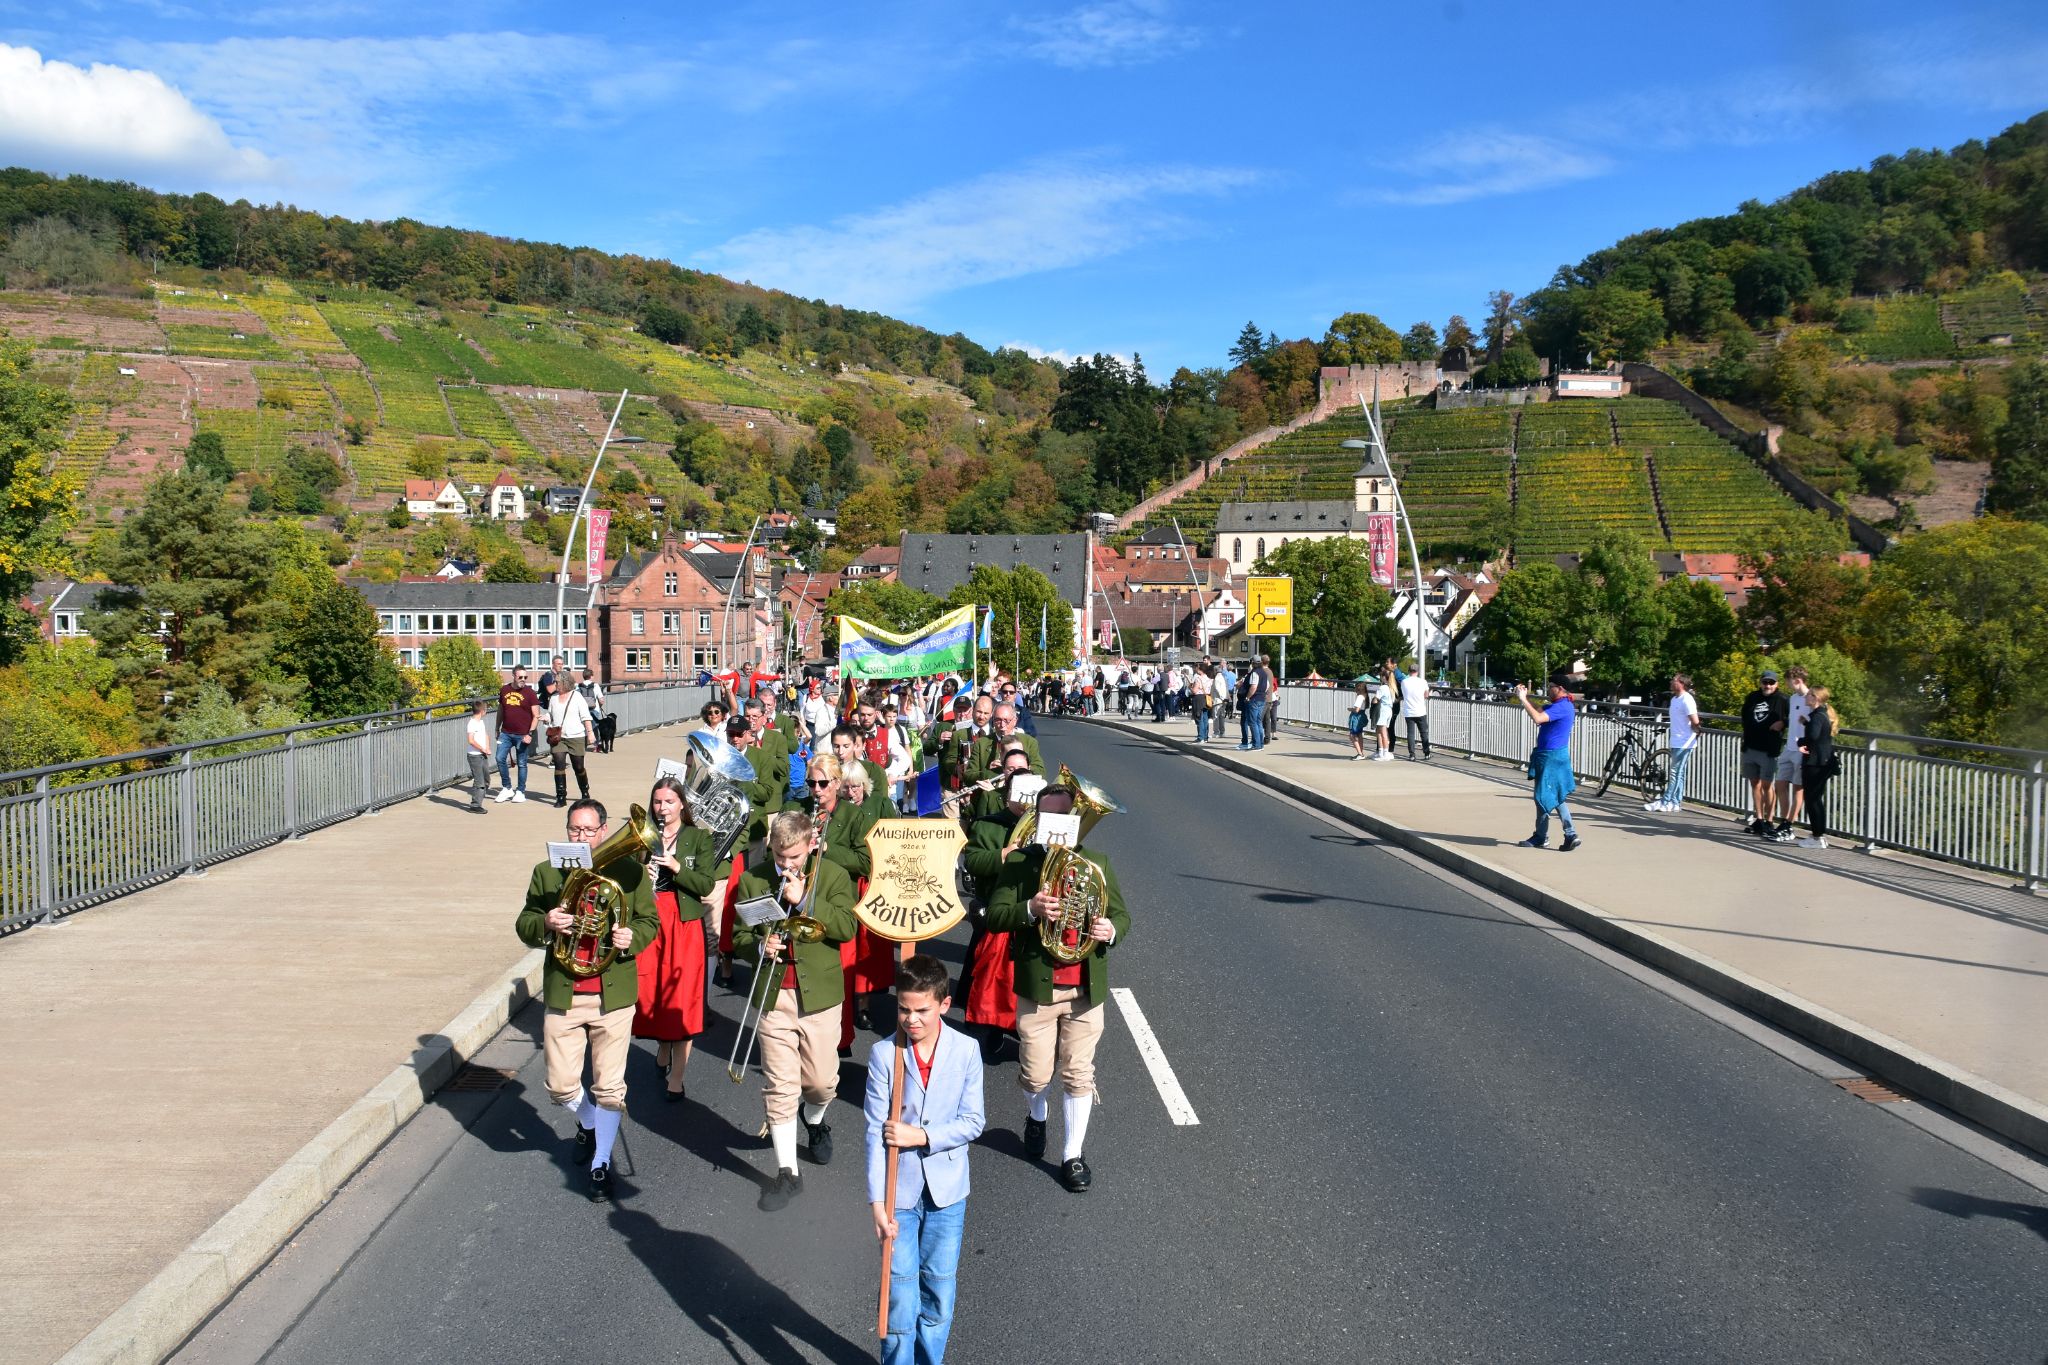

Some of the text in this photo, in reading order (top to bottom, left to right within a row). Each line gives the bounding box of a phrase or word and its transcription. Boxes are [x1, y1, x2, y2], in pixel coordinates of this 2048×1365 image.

[933, 658, 957, 669] MAIN
[873, 827, 955, 839] Musikverein
[865, 894, 954, 932] Röllfeld
